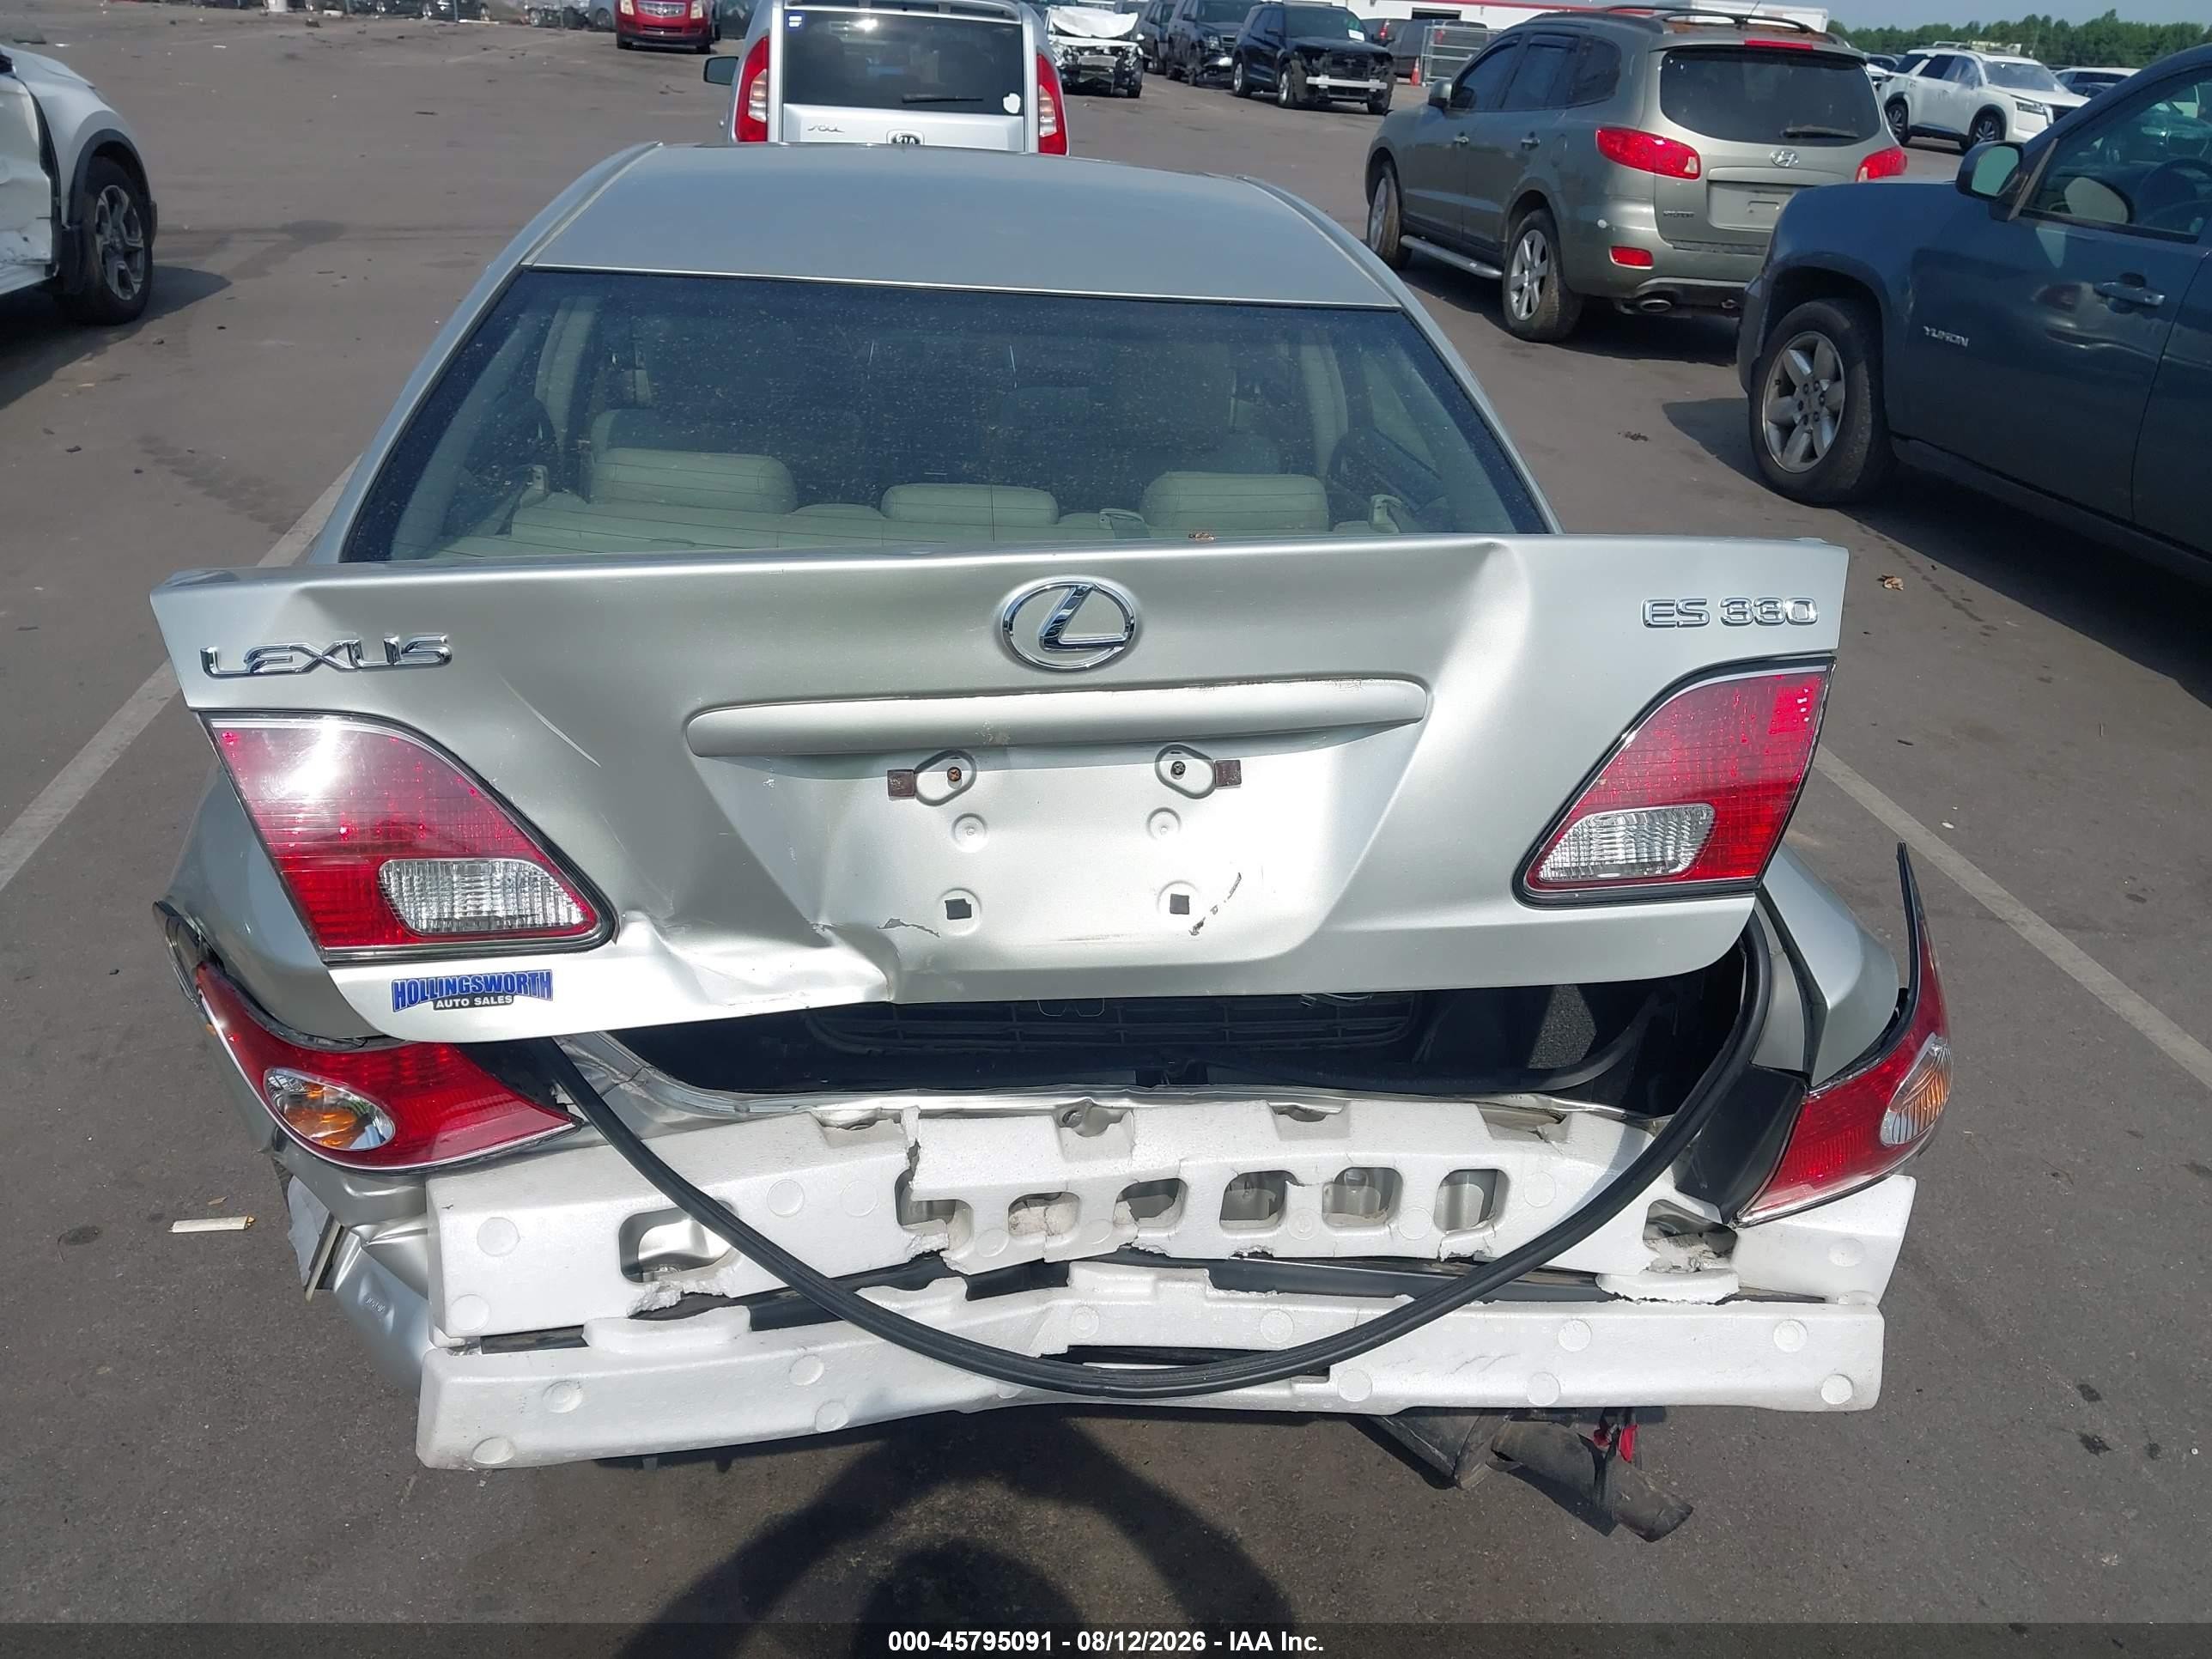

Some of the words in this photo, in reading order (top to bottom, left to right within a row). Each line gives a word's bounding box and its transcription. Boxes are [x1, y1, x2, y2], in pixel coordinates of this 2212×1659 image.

[1642, 598, 1711, 628] ES
[1720, 597, 1818, 627] 330
[199, 634, 453, 679] LEXUS
[392, 970, 553, 1012] HOLLINGSWORTH
[435, 998, 470, 1009] AUTO
[473, 995, 513, 1006] SALES
